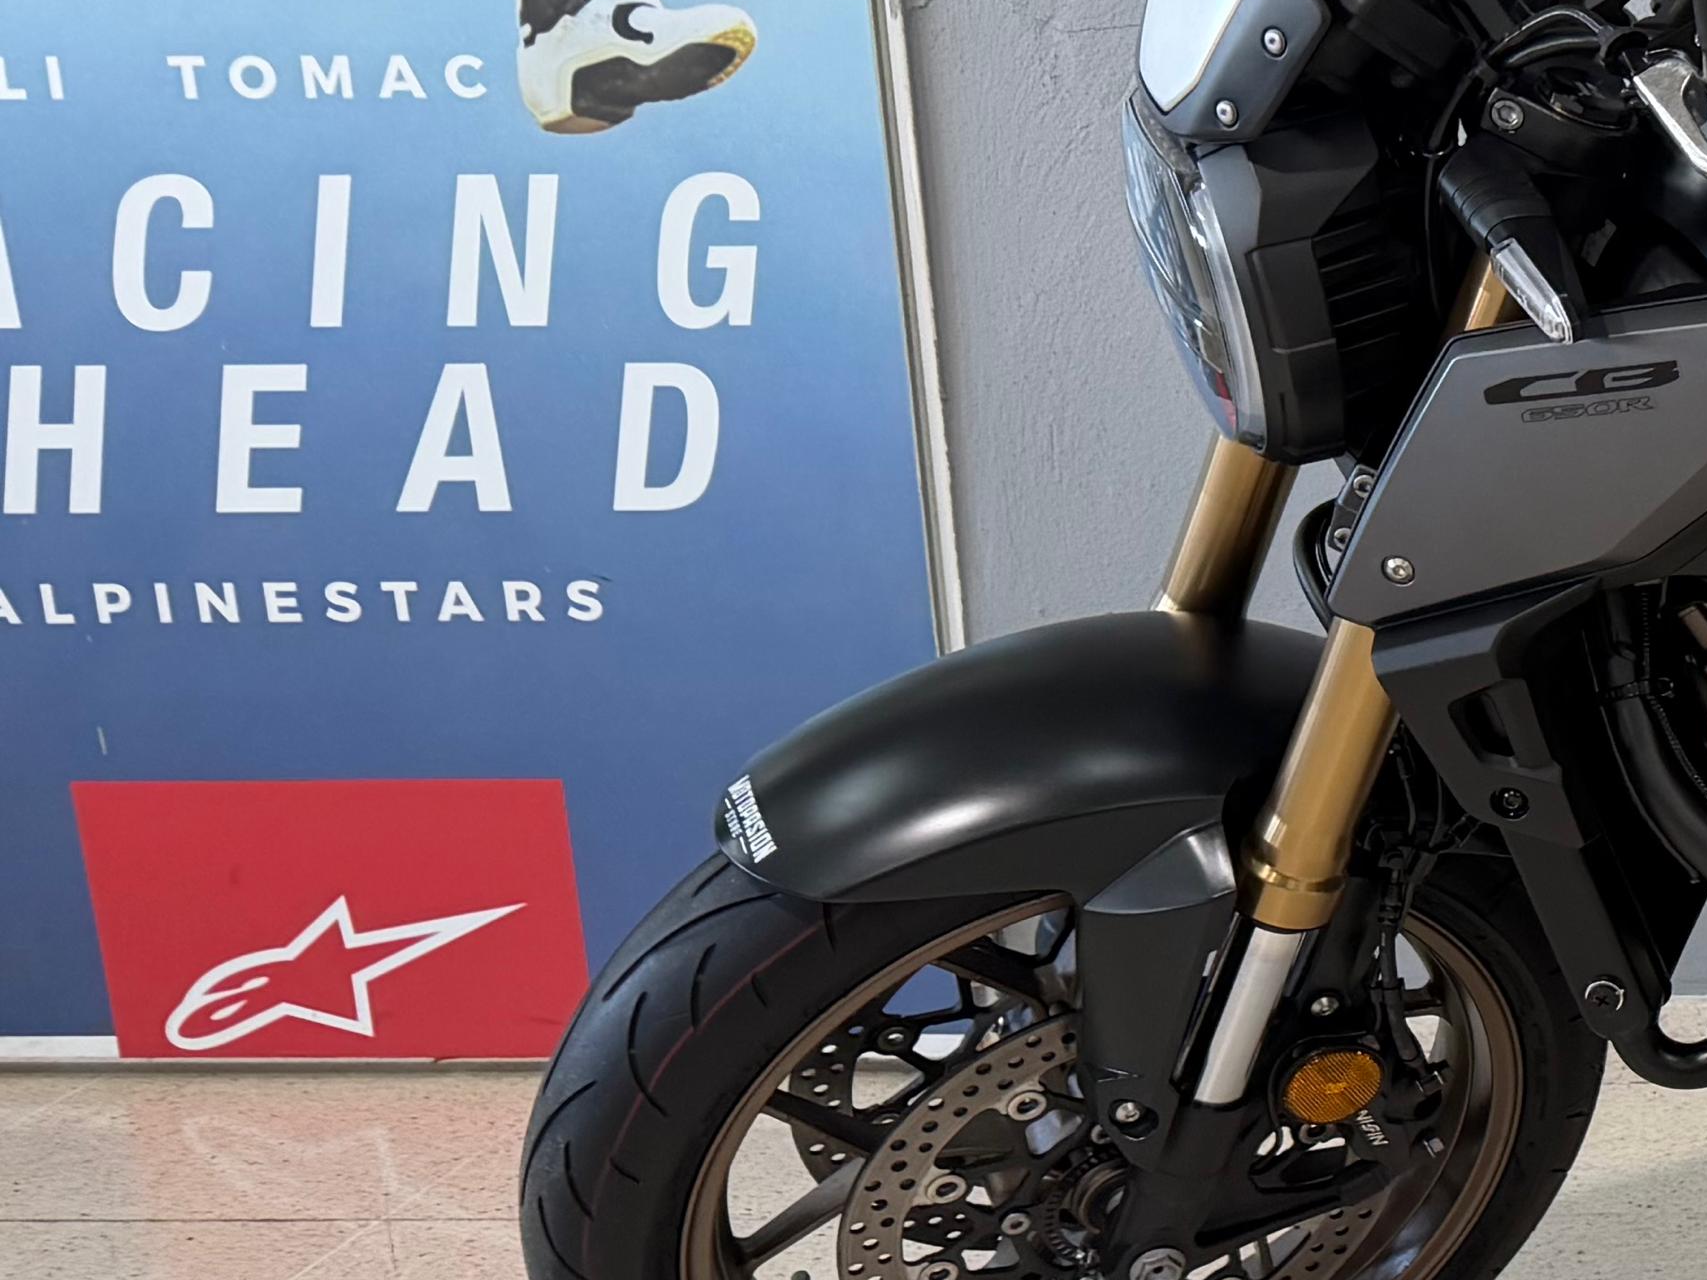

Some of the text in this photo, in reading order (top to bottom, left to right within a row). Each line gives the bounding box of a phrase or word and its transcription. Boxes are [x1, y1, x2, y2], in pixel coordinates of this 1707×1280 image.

[168, 54, 488, 100] TOMAC
[0, 172, 762, 332] CING
[1483, 359, 1681, 406] CB
[1520, 395, 1654, 424] 650R
[3, 362, 720, 515] HEAD
[727, 773, 779, 864] MOTOPASION
